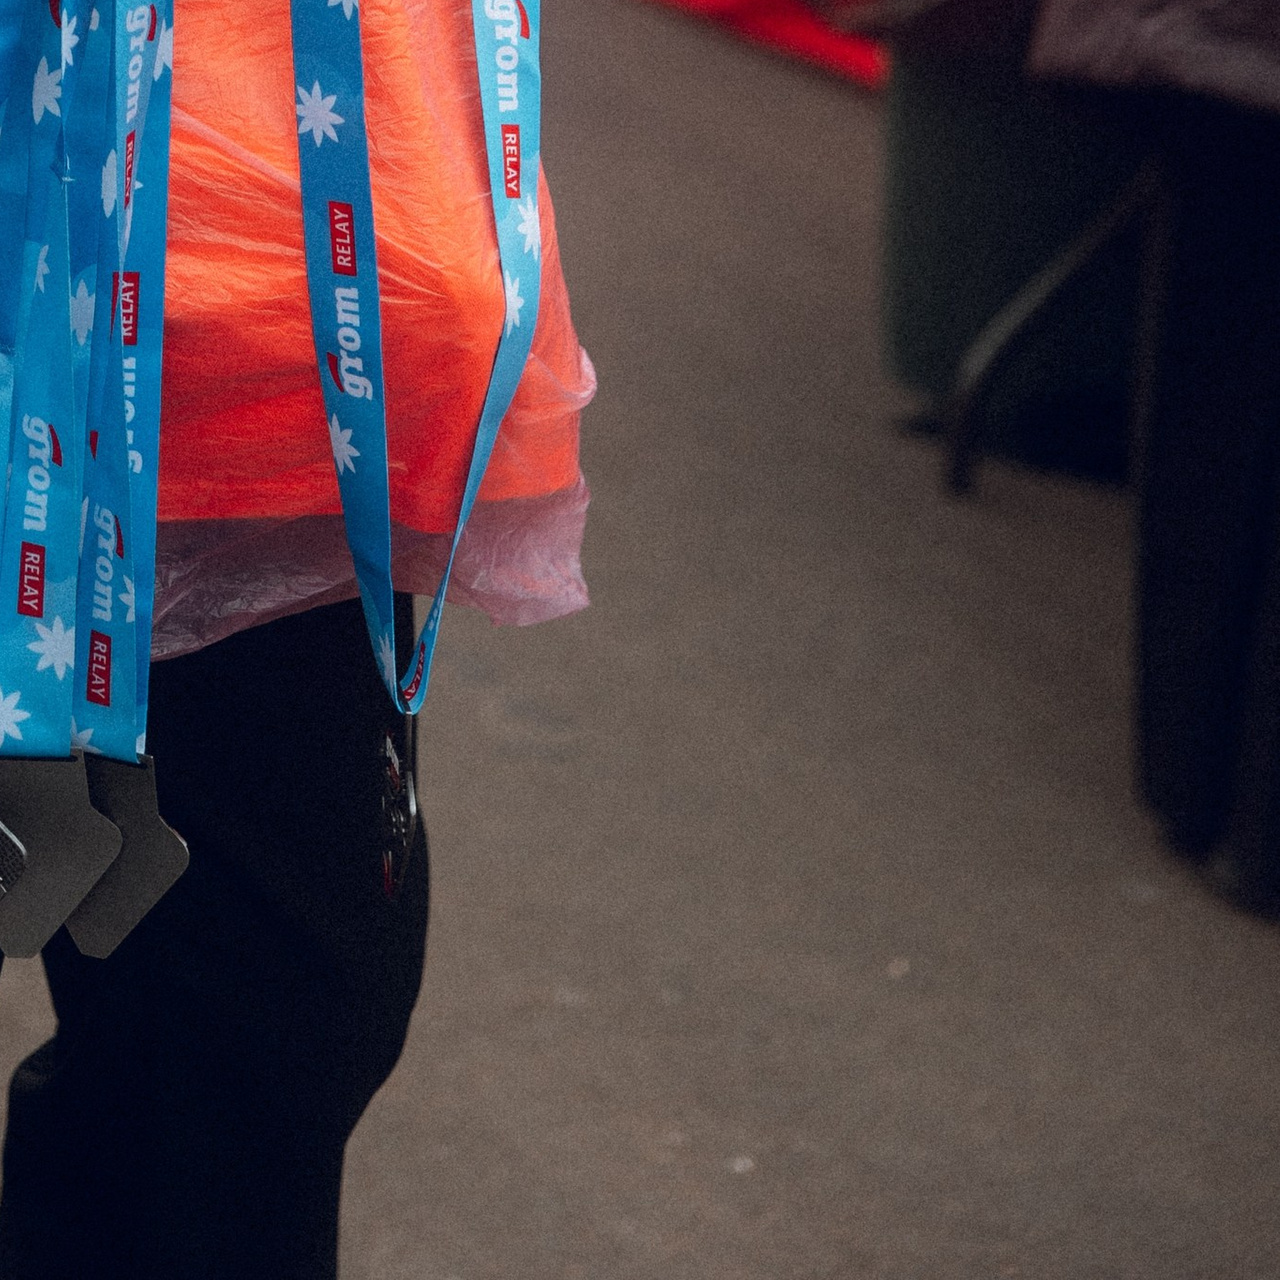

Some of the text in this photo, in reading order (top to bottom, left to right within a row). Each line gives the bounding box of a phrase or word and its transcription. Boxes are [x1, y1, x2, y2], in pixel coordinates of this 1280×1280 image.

[125, 4, 150, 124] grom
[504, 132, 520, 193] RELAY
[333, 207, 374, 401] grom RELAY
[21, 412, 53, 611] grom RELAY
[89, 502, 116, 700] grom RELAY
